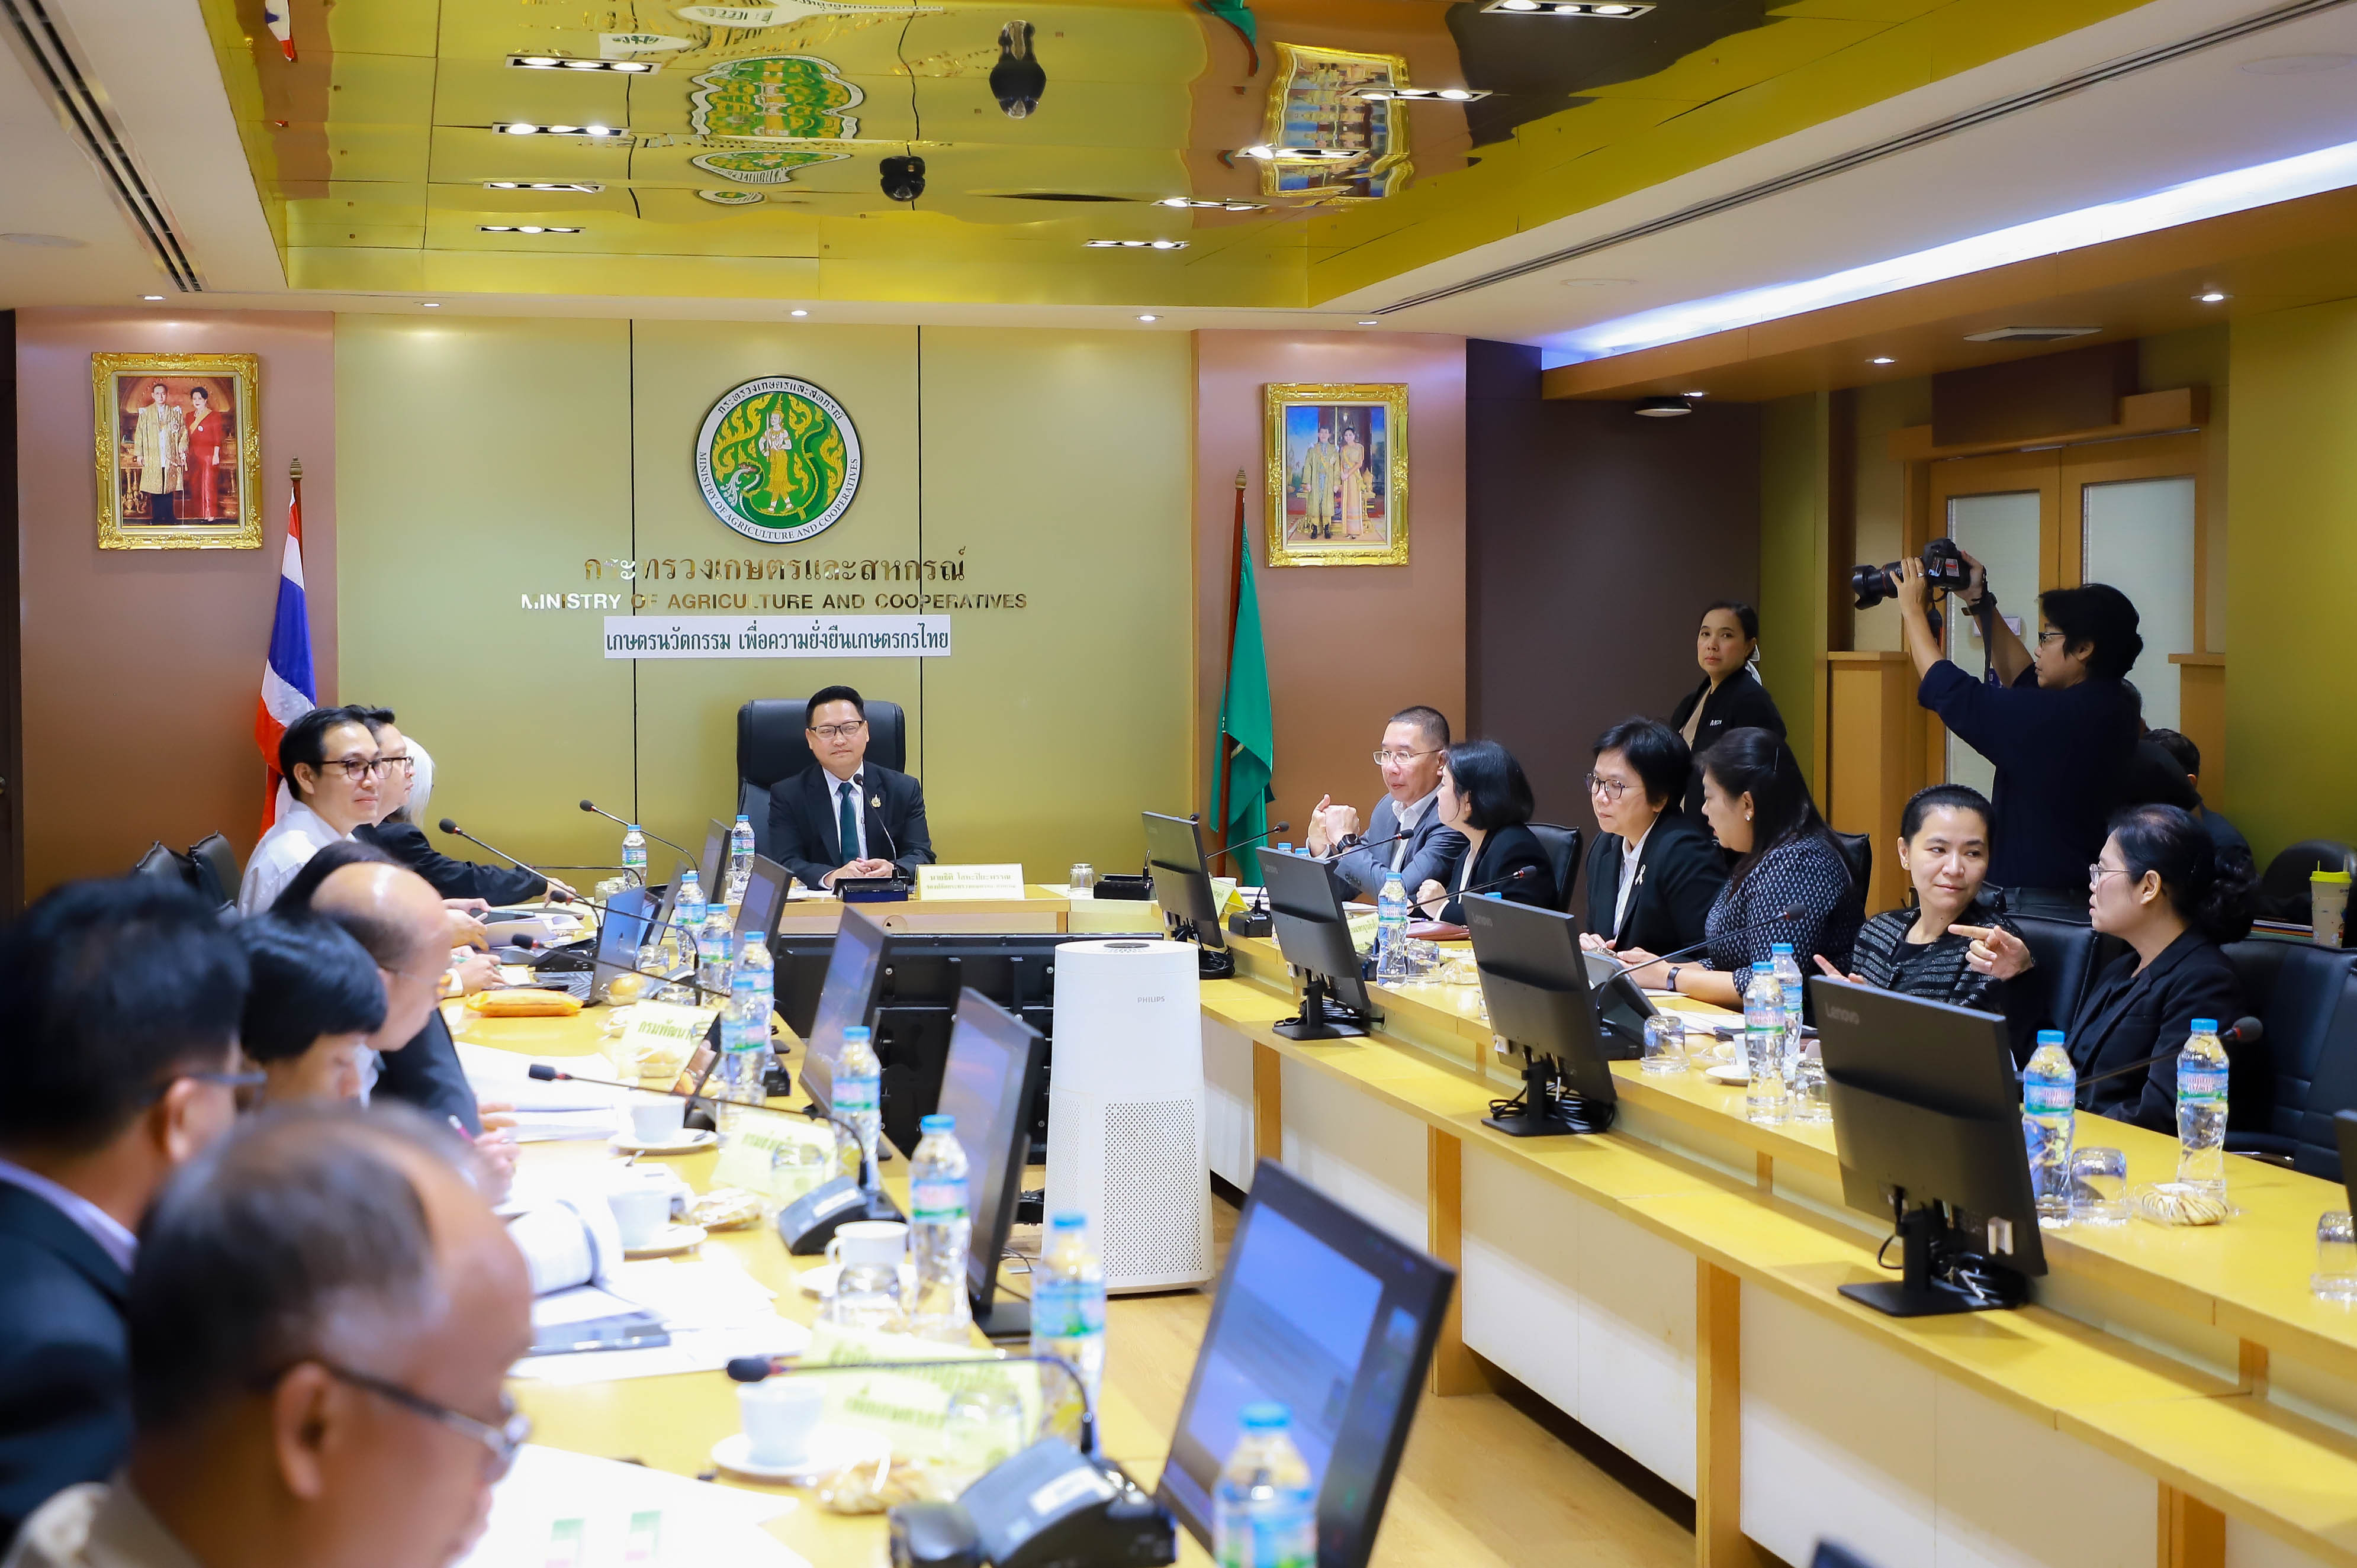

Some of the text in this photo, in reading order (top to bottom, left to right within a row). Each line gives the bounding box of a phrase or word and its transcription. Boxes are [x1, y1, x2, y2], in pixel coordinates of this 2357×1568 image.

[699, 451, 858, 540] MINISTRY OF AGRICULTURE AND COOPERATIVES
[521, 593, 622, 610] MINISTRY
[631, 593, 658, 610] OF
[822, 593, 866, 610] AND
[874, 593, 1028, 610] COOPERATIVES
[606, 619, 948, 651] เกษตรนวัตกรรม เพื่อความยั่งยืนเกษตรกรไทย
